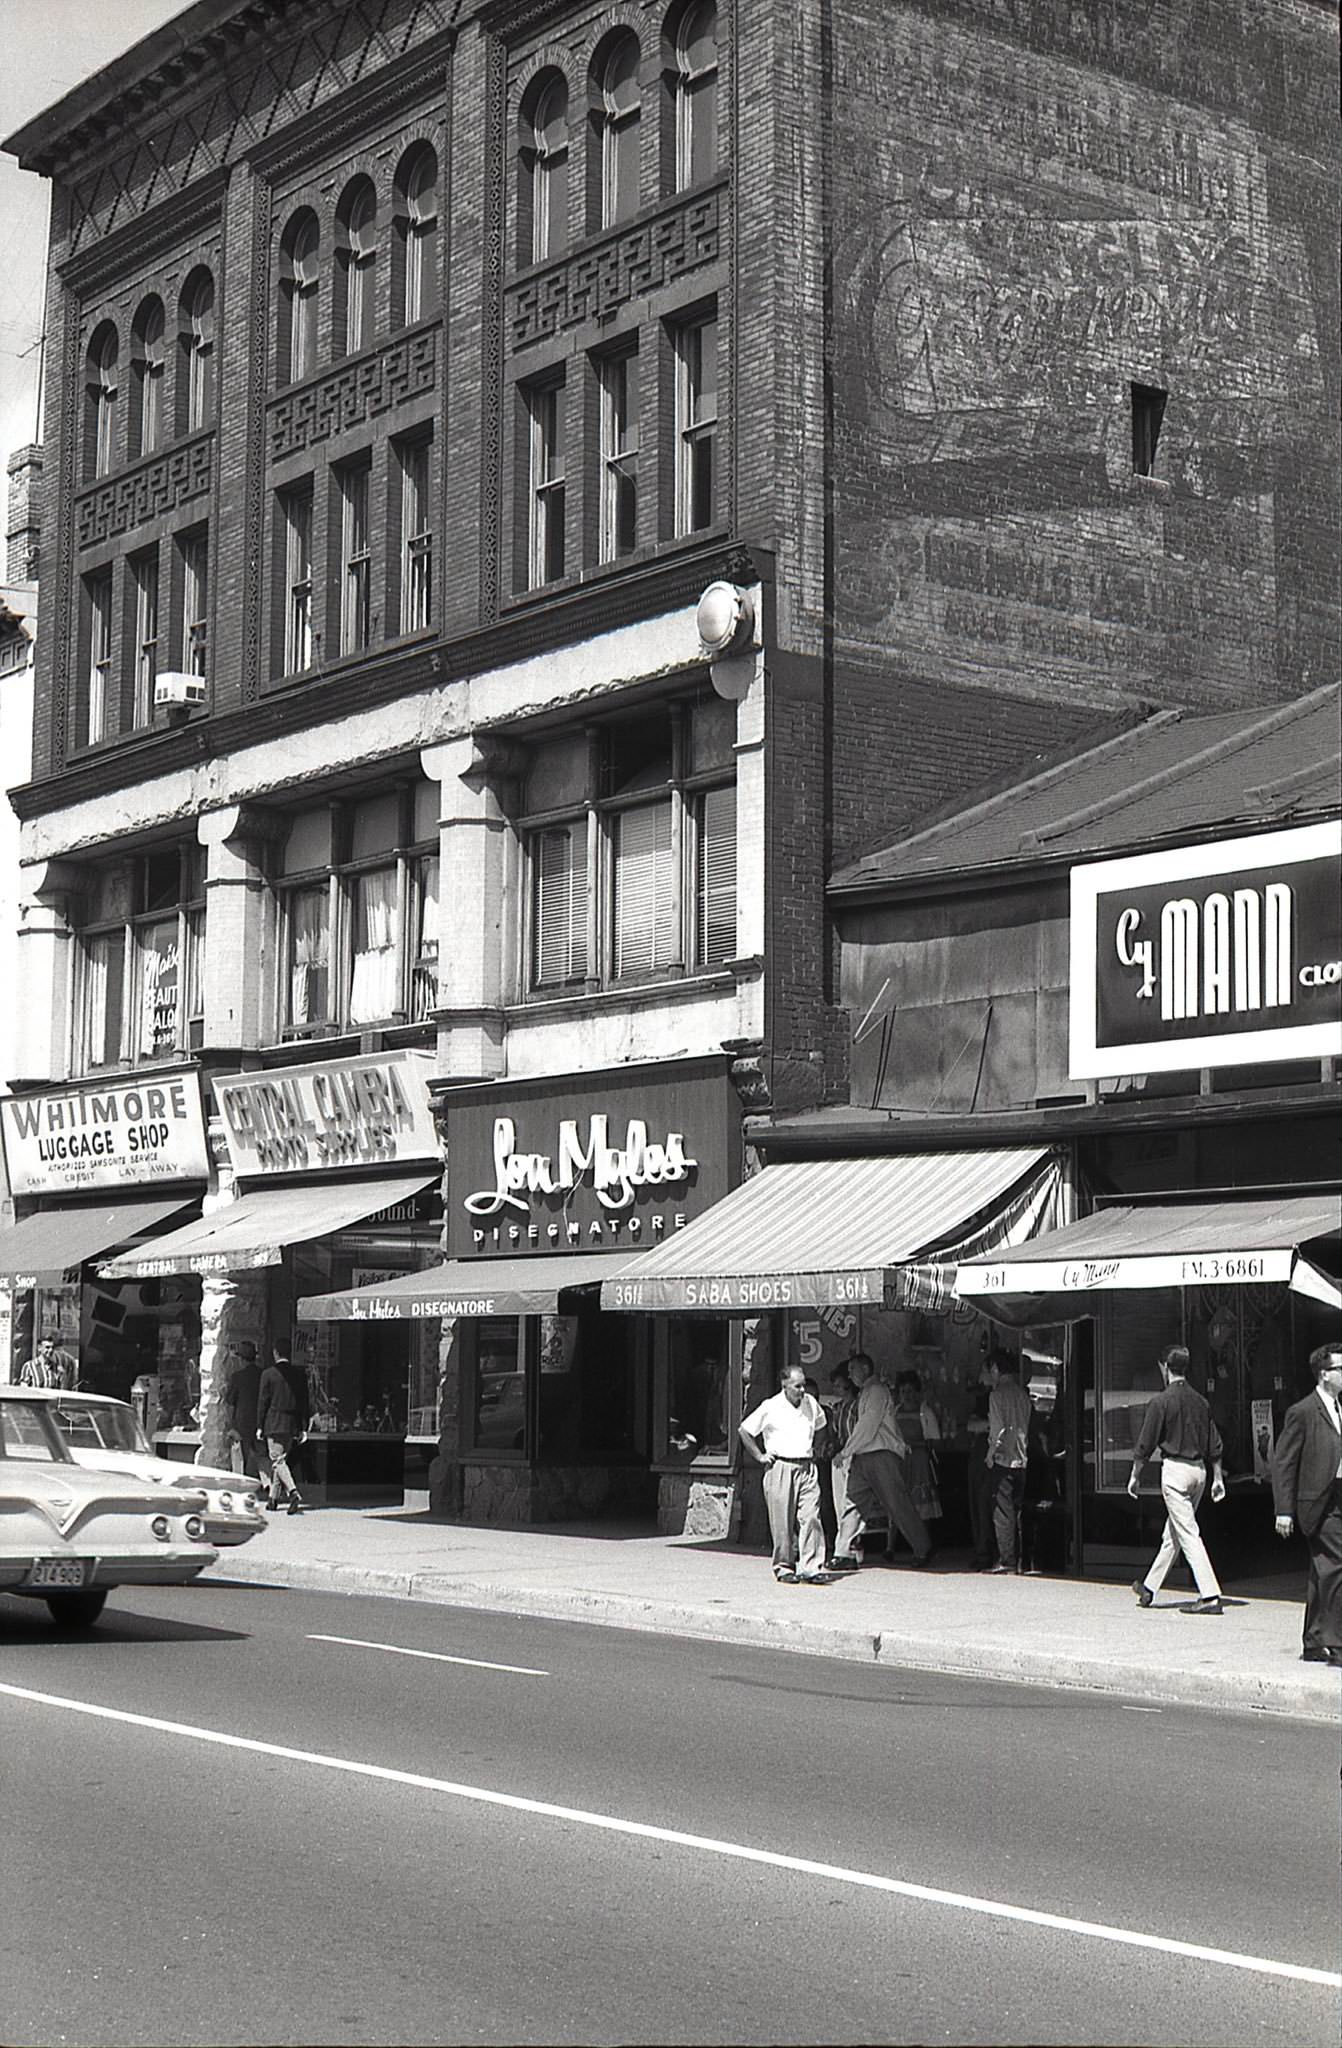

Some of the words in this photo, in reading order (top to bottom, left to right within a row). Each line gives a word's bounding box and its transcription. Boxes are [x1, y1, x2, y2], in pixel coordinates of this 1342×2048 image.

[1116, 908, 1156, 998] Cy
[1161, 882, 1292, 1021] MANN
[1299, 961, 1341, 986] CLO
[10, 1085, 187, 1140] WHITMORE
[312, 1065, 415, 1133] CAMERA
[38, 1129, 115, 1162] LUGGAGE
[127, 1123, 169, 1152] SHOP
[558, 1114, 698, 1208] Myles
[64, 1171, 95, 1182] CREDIT
[473, 1212, 686, 1241] DISEGNATORE
[412, 1300, 494, 1316] DISEGNATORE
[686, 1283, 733, 1305] SABA
[739, 1281, 792, 1304] SHOES
